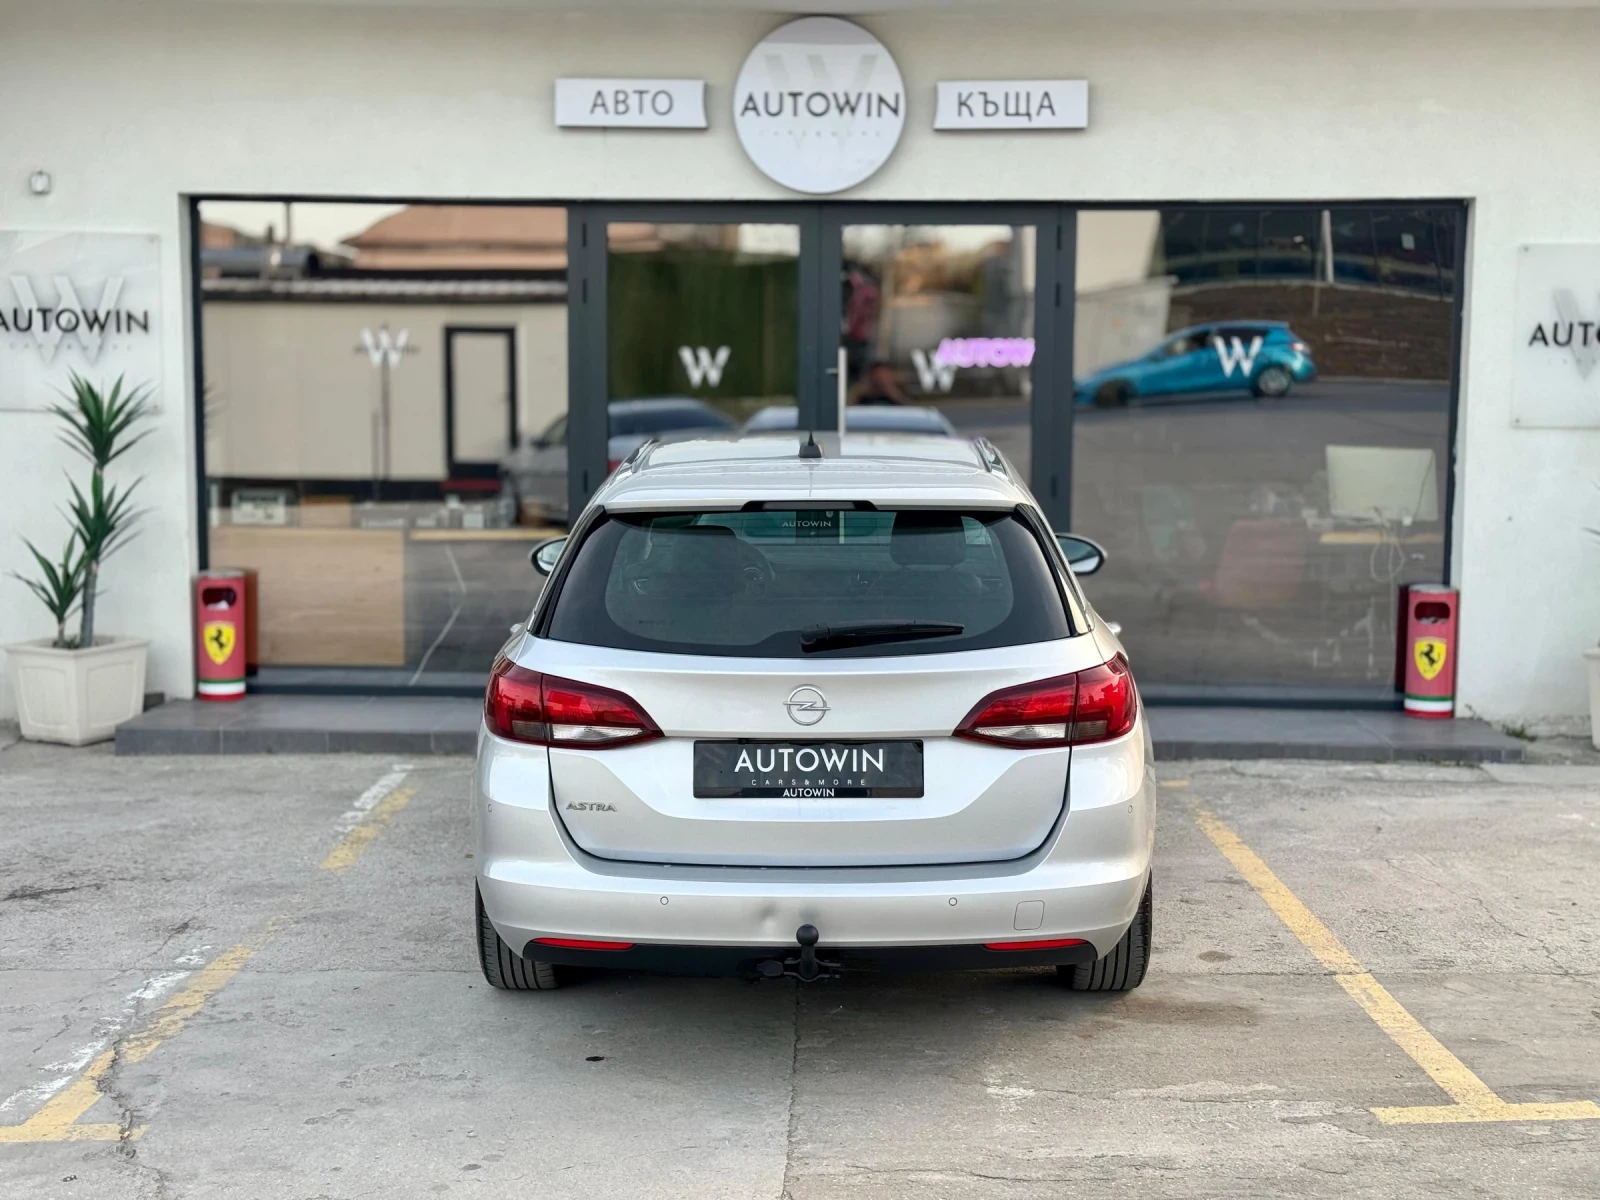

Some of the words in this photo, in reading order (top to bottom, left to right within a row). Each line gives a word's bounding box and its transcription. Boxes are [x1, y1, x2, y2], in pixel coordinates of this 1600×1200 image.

[589, 89, 674, 116] АВТО
[740, 91, 900, 118] AUTOWIN
[957, 91, 1055, 121] КЪЩА
[1528, 321, 1600, 347] AUT
[678, 345, 732, 388] W
[1213, 335, 1263, 378] W
[734, 748, 884, 773] AUTOWIN
[566, 801, 617, 812] ASTRA
[782, 788, 835, 798] AUTOWIN
